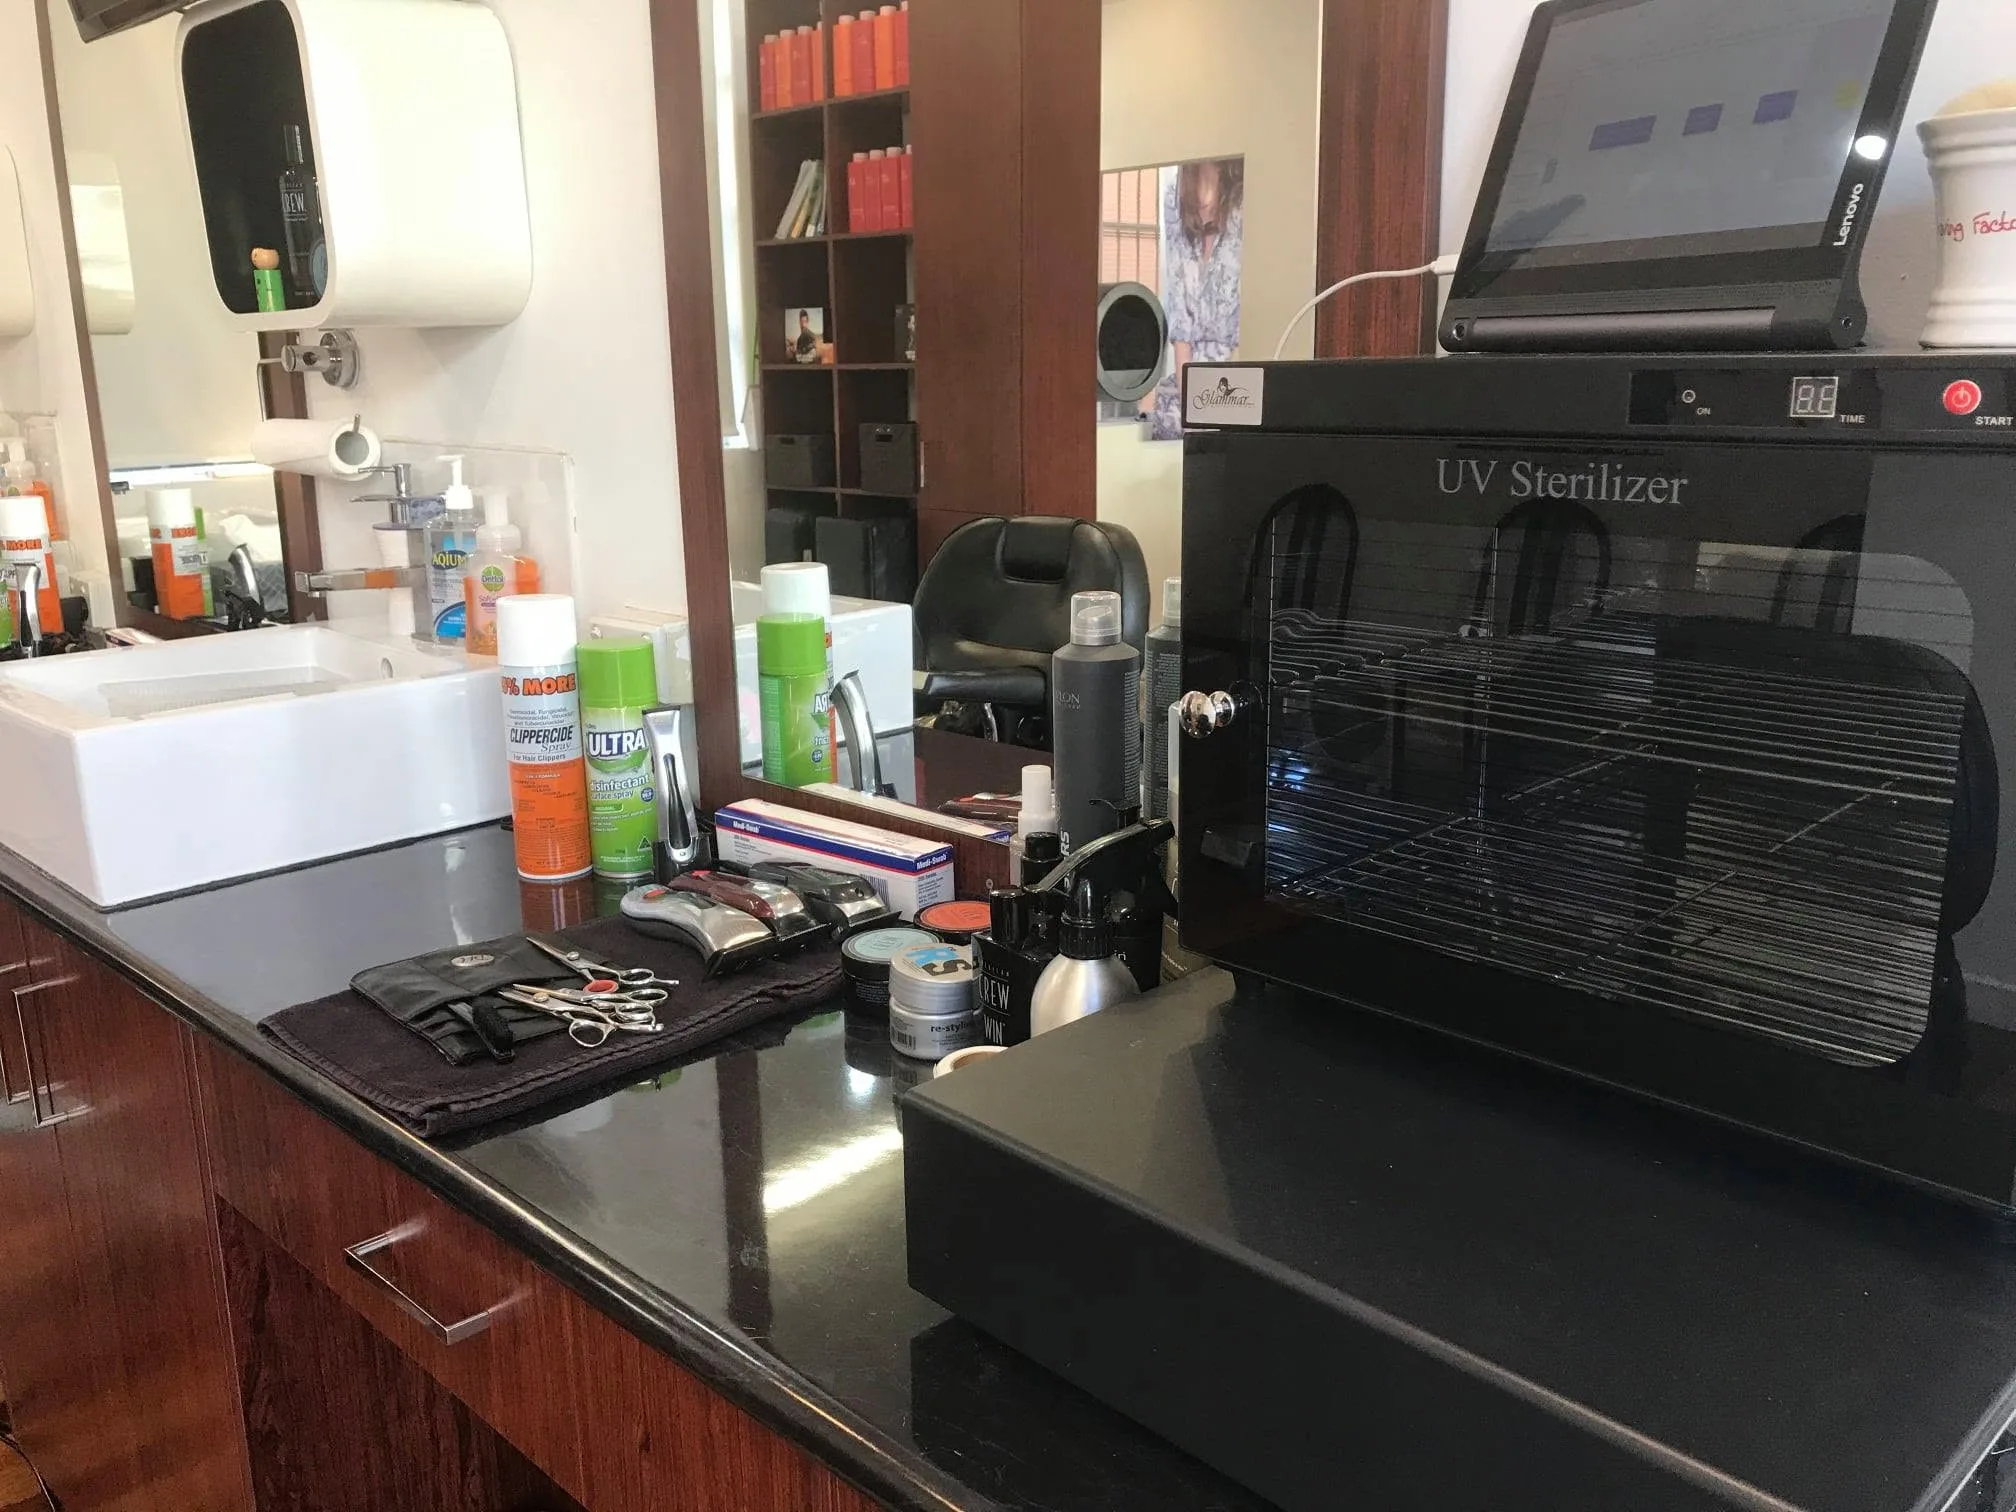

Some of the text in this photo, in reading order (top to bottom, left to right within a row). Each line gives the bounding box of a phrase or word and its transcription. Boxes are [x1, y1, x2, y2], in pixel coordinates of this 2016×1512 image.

[1833, 183, 1864, 246] Lenovo
[1696, 407, 1711, 416] ON
[1840, 414, 1866, 424] TIME
[1974, 415, 2014, 426] START
[1436, 458, 1689, 505] UV Sterilizer
[480, 575, 505, 583] Dettol
[522, 673, 576, 696] MORE
[510, 725, 575, 744] CLIPPERCIDE
[540, 742, 571, 754] Spray
[588, 729, 647, 757] ULTRA
[537, 753, 567, 762] Clippers
[613, 790, 634, 800] spray
